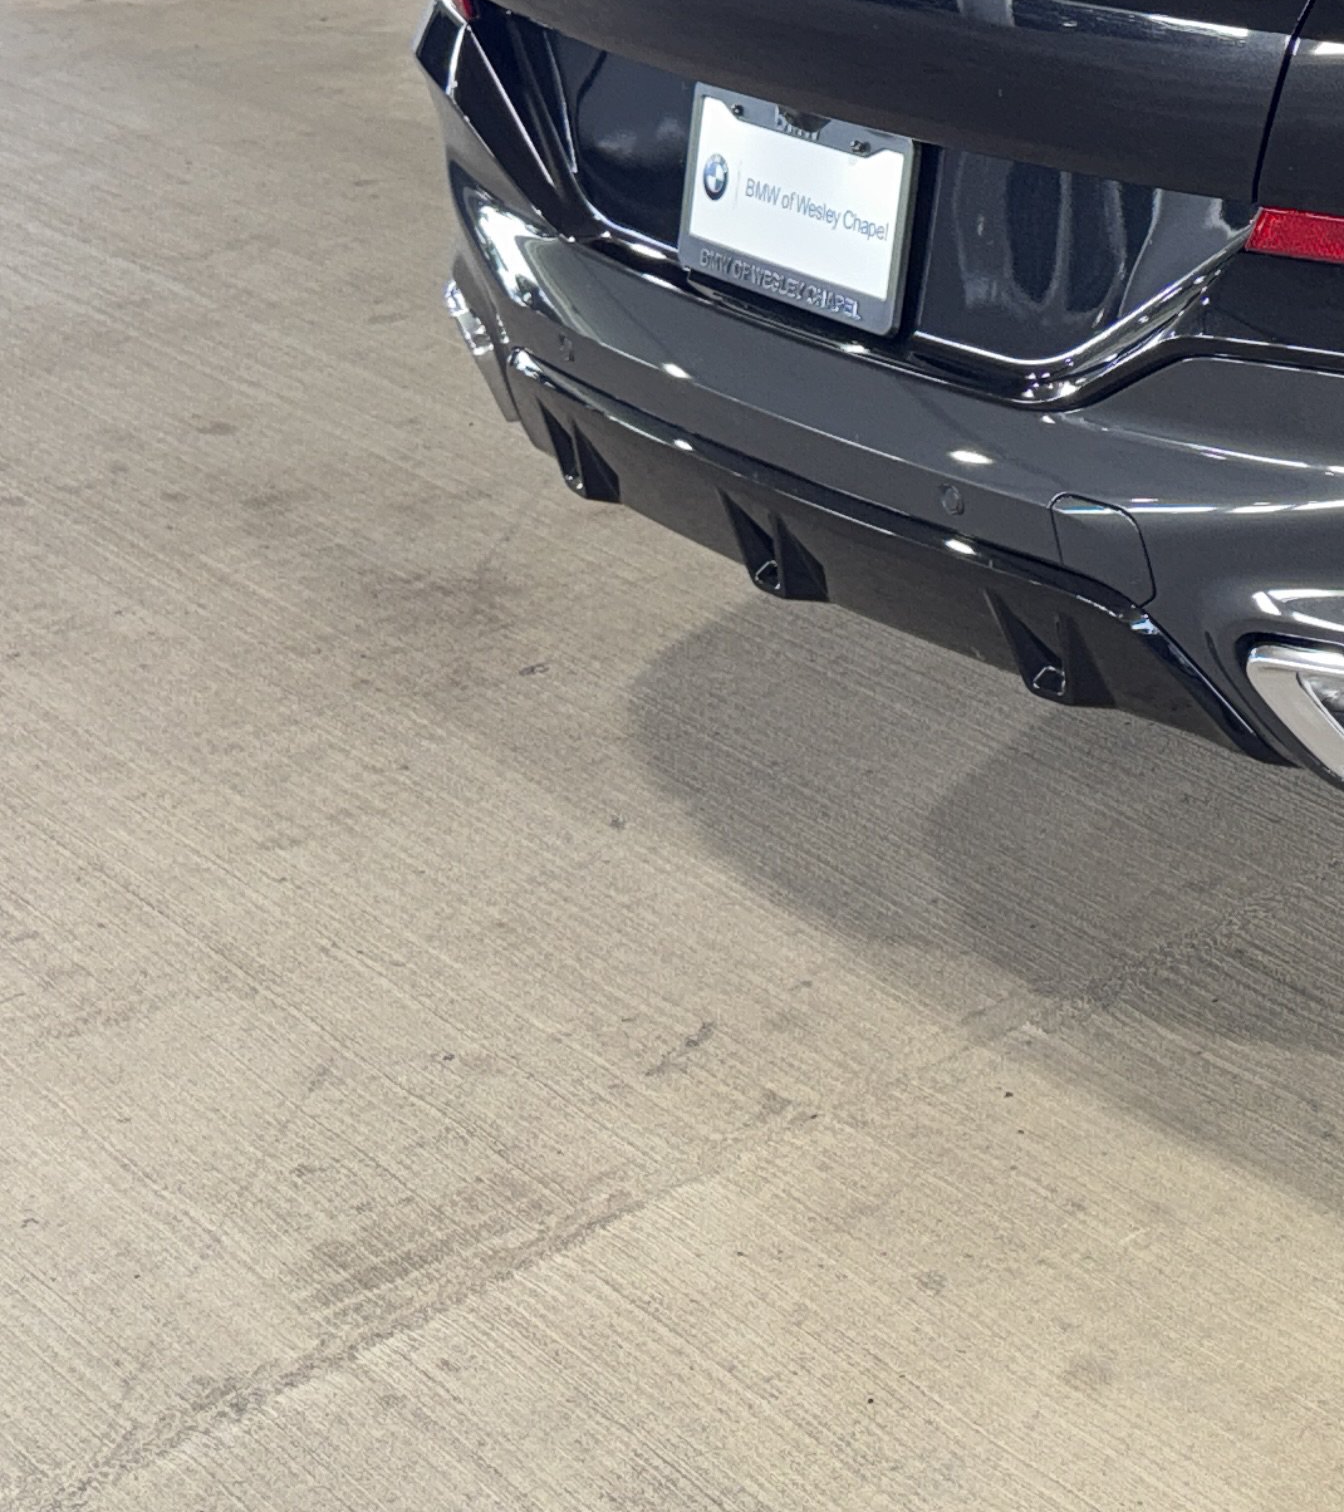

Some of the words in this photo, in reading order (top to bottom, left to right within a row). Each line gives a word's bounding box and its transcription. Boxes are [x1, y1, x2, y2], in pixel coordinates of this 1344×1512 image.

[745, 178, 781, 206] BMW
[781, 192, 796, 211] of
[795, 196, 842, 230] Wesley
[843, 210, 890, 241] Chapel
[700, 248, 733, 274] BMW
